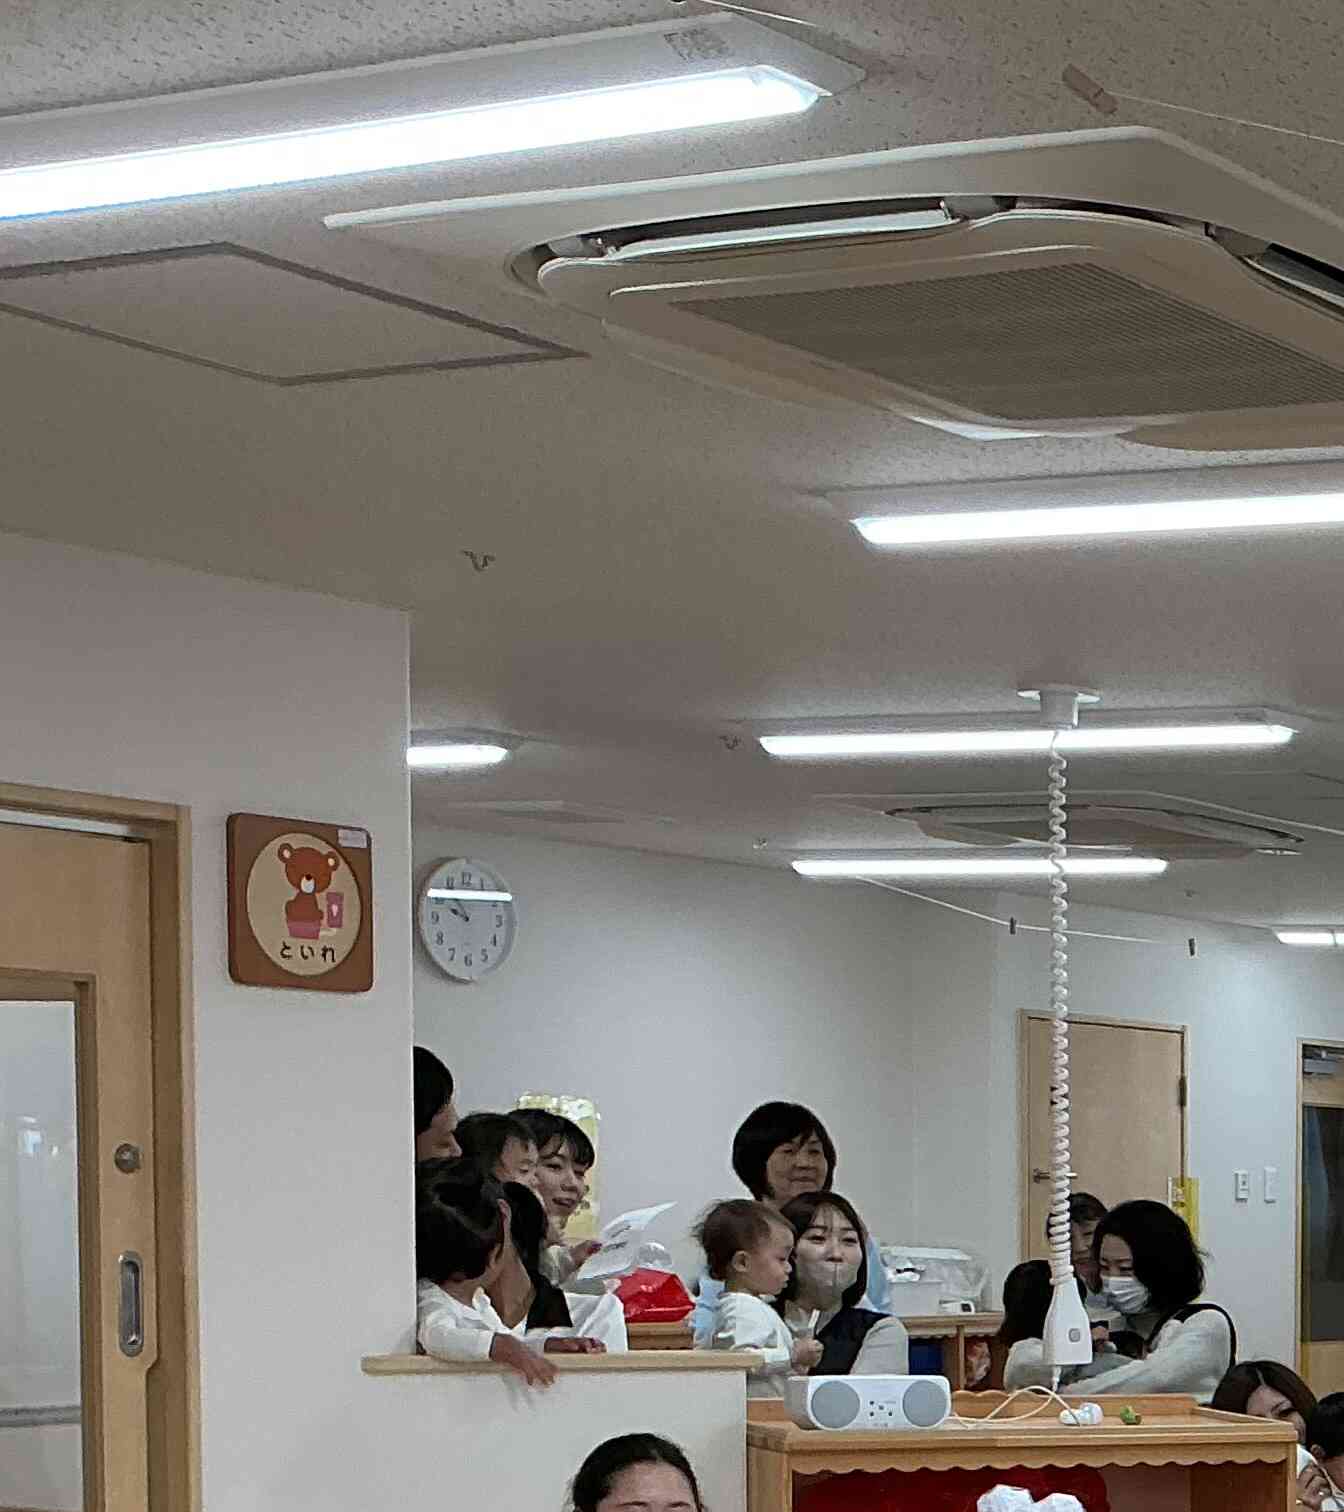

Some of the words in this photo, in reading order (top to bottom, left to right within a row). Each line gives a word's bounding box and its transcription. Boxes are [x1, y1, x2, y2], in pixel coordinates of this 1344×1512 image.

[461, 871, 472, 886] 12
[431, 912, 440, 924] 9
[495, 915, 503, 928] 3
[436, 931, 444, 945] 8
[490, 934, 497, 947] 4
[280, 941, 336, 963] といれ
[448, 948, 456, 961] 7
[481, 949, 488, 962] 5
[464, 953, 472, 967] 6
